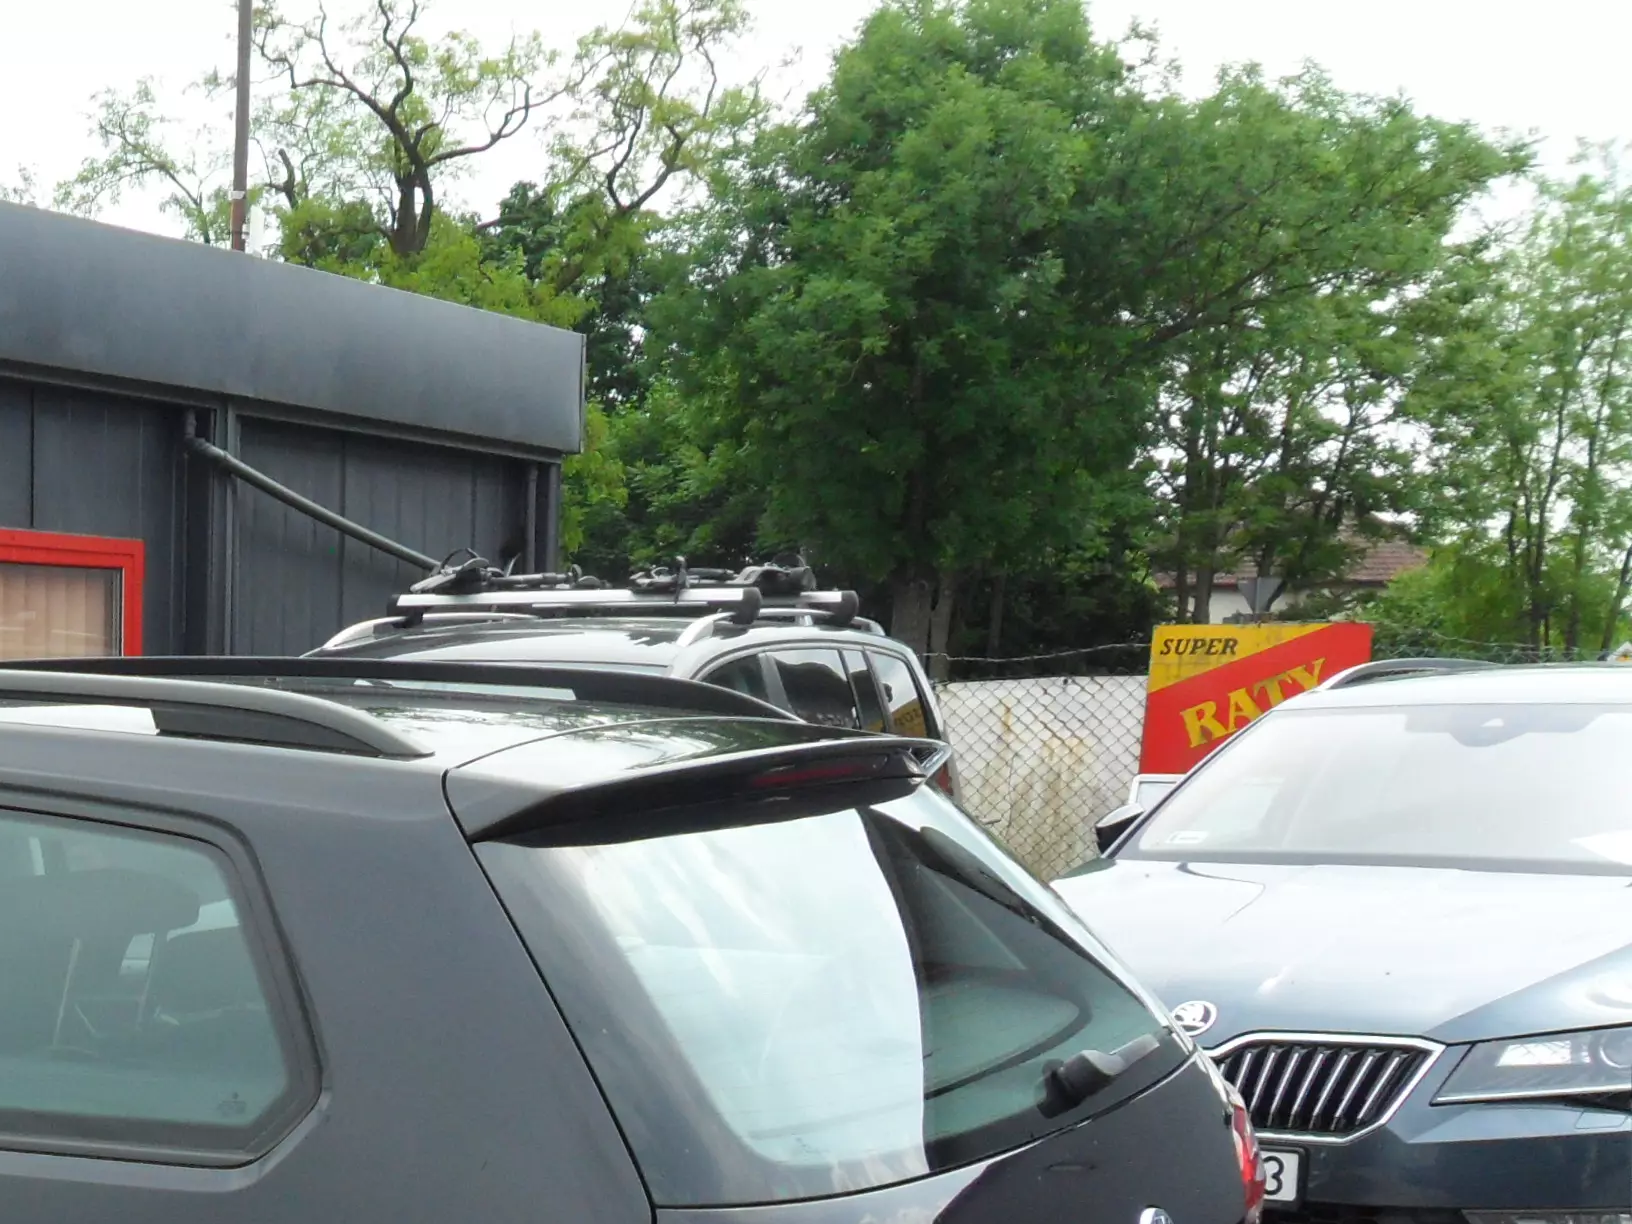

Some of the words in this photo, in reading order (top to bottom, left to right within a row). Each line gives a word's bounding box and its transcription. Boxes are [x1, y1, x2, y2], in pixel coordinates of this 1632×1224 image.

[1159, 637, 1239, 656] SUPER
[1179, 657, 1327, 749] RATY
[1262, 1154, 1285, 1196] 3
